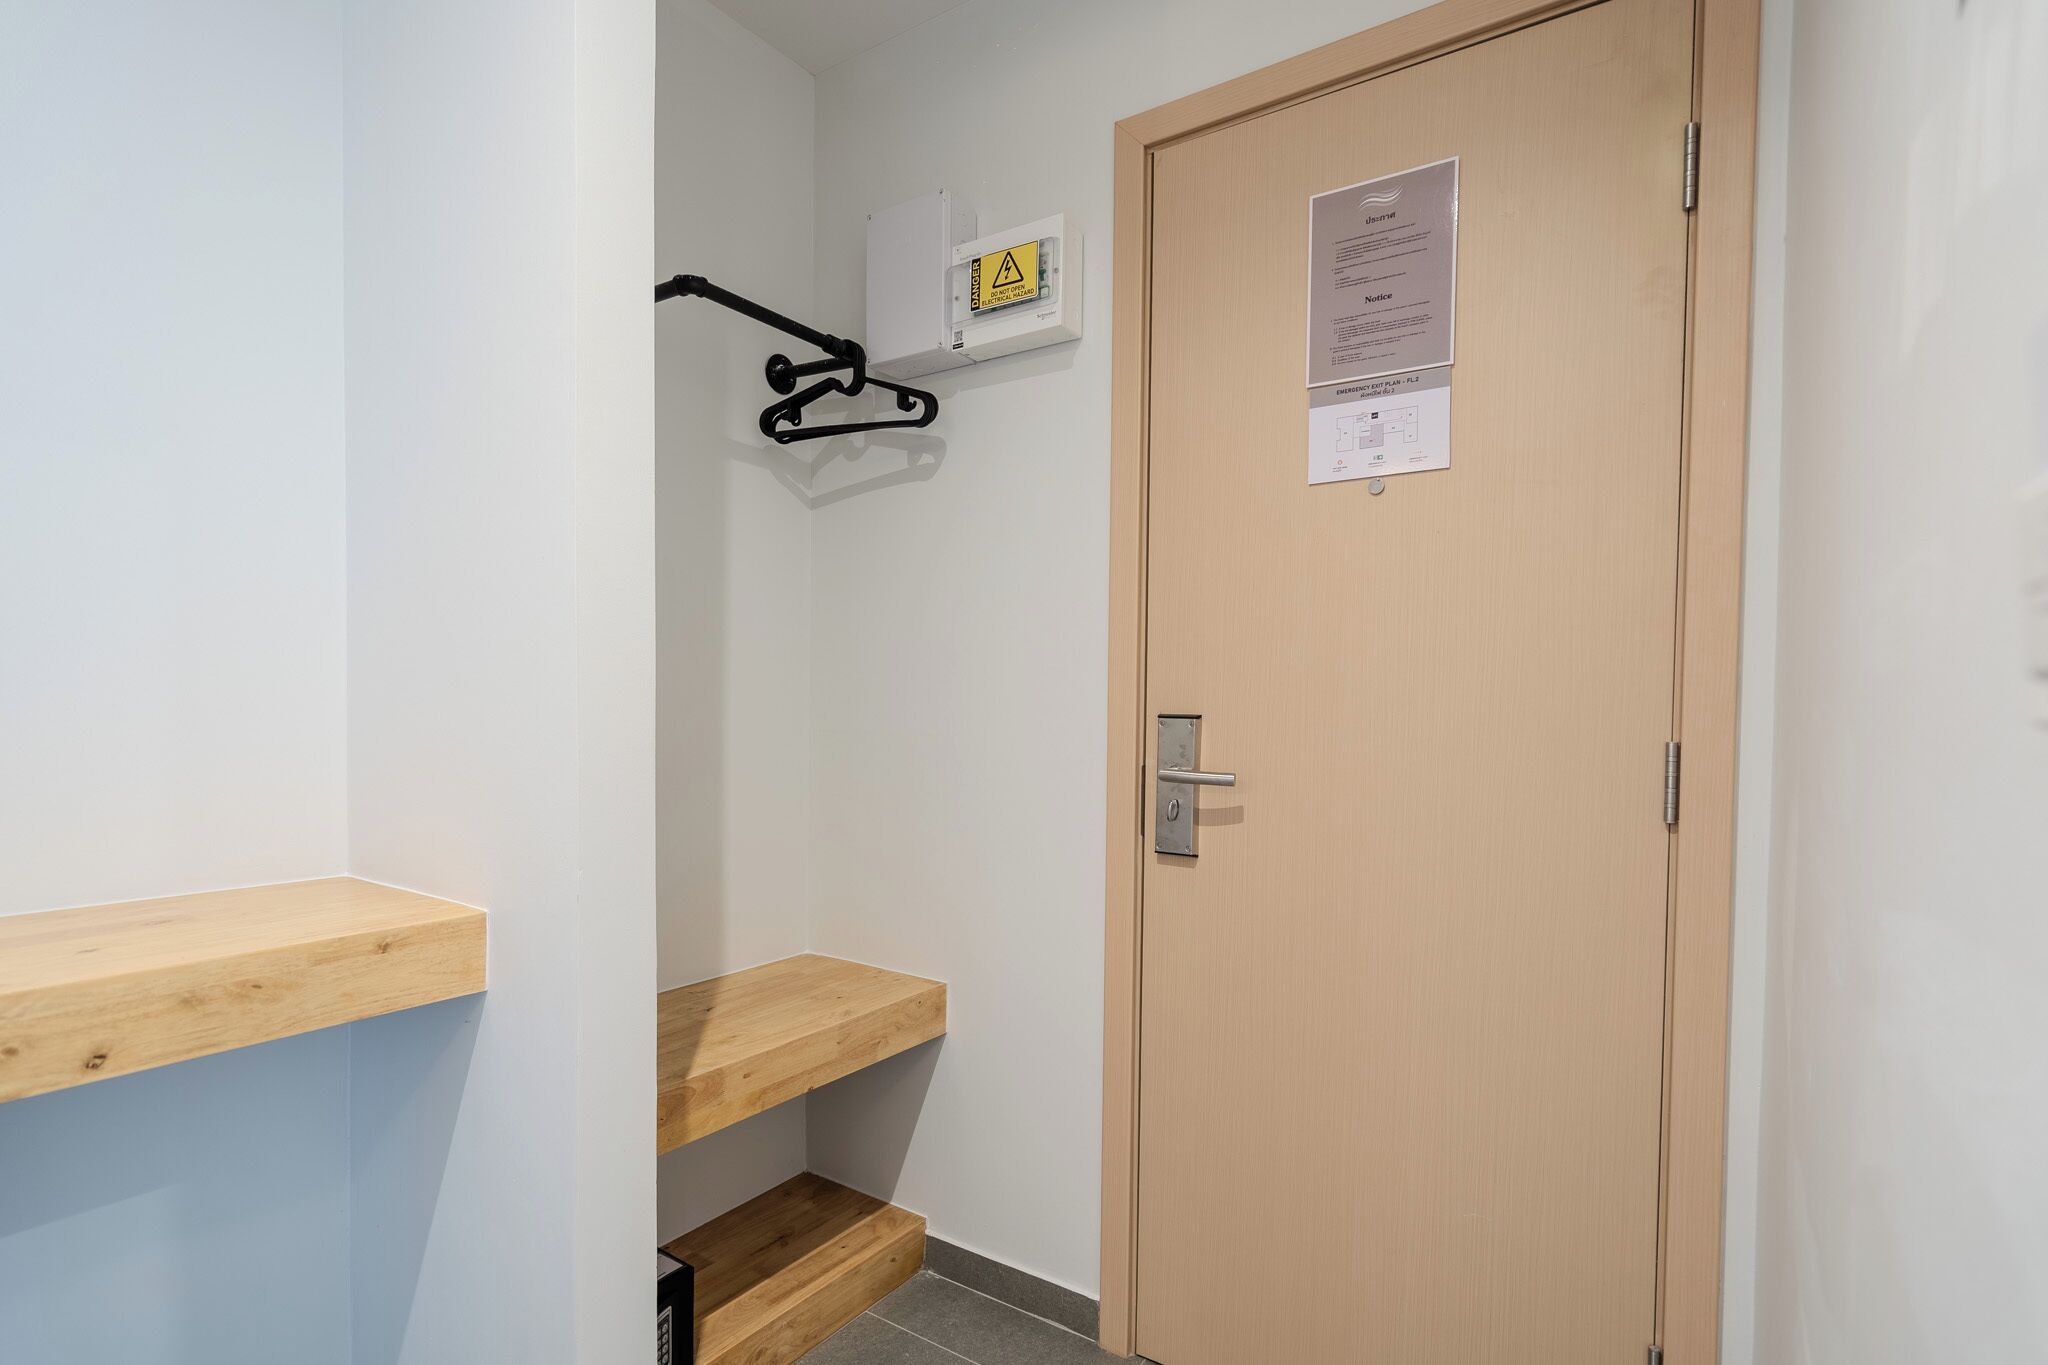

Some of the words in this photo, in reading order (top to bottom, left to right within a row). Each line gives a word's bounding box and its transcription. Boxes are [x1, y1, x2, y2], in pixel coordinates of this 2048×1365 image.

[1365, 211, 1396, 225] ประกาศ
[971, 261, 980, 308] DANGER
[999, 288, 1010, 296] NOT
[1011, 284, 1025, 292] OPEN
[982, 294, 1012, 306] ELECTRICAL
[1013, 288, 1035, 298] HAZARD
[1364, 293, 1393, 304] Notice
[1336, 385, 1371, 396] EMERGENCY
[1371, 382, 1384, 390] EXIT
[1385, 379, 1401, 387] PLAN
